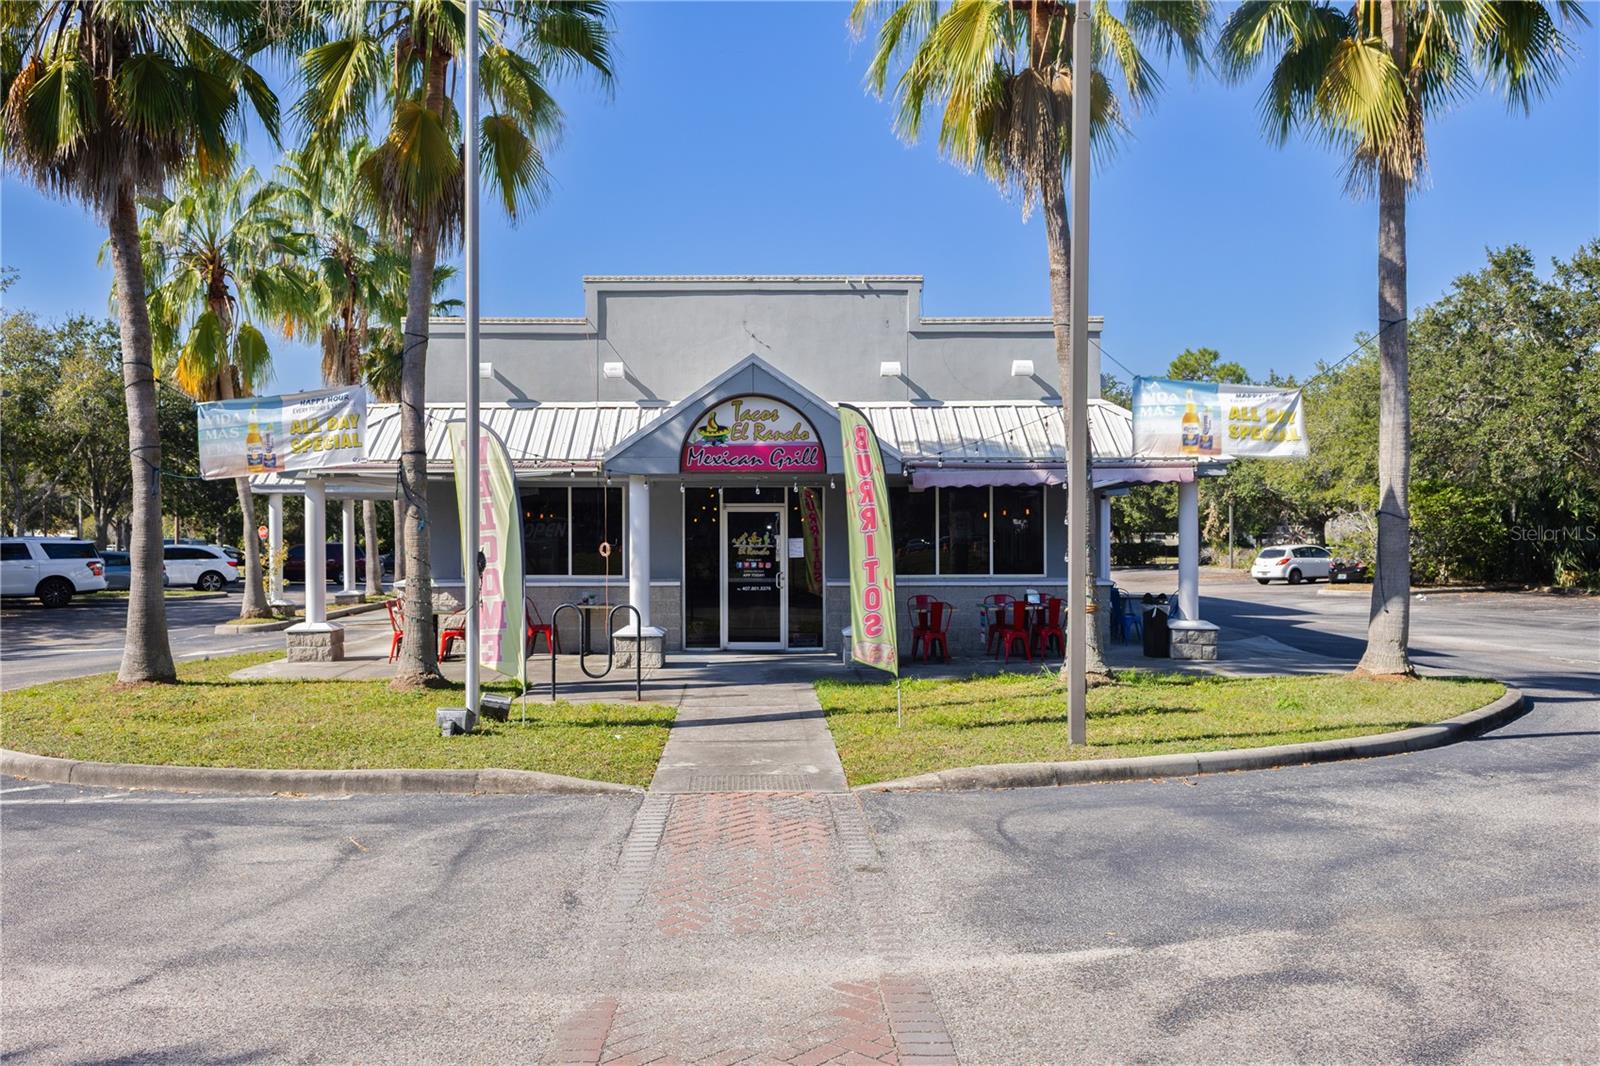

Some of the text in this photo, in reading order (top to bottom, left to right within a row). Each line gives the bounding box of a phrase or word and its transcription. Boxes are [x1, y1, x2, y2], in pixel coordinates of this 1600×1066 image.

[300, 397, 326, 405] HAPPY
[328, 394, 350, 402] HOUR
[731, 400, 780, 422] Tacos
[1229, 405, 1261, 422] ALL
[290, 414, 360, 434] ALL DAY
[730, 421, 810, 442] El Rancho
[290, 432, 363, 454] SPECIAL
[686, 447, 818, 470] Mexican Grill
